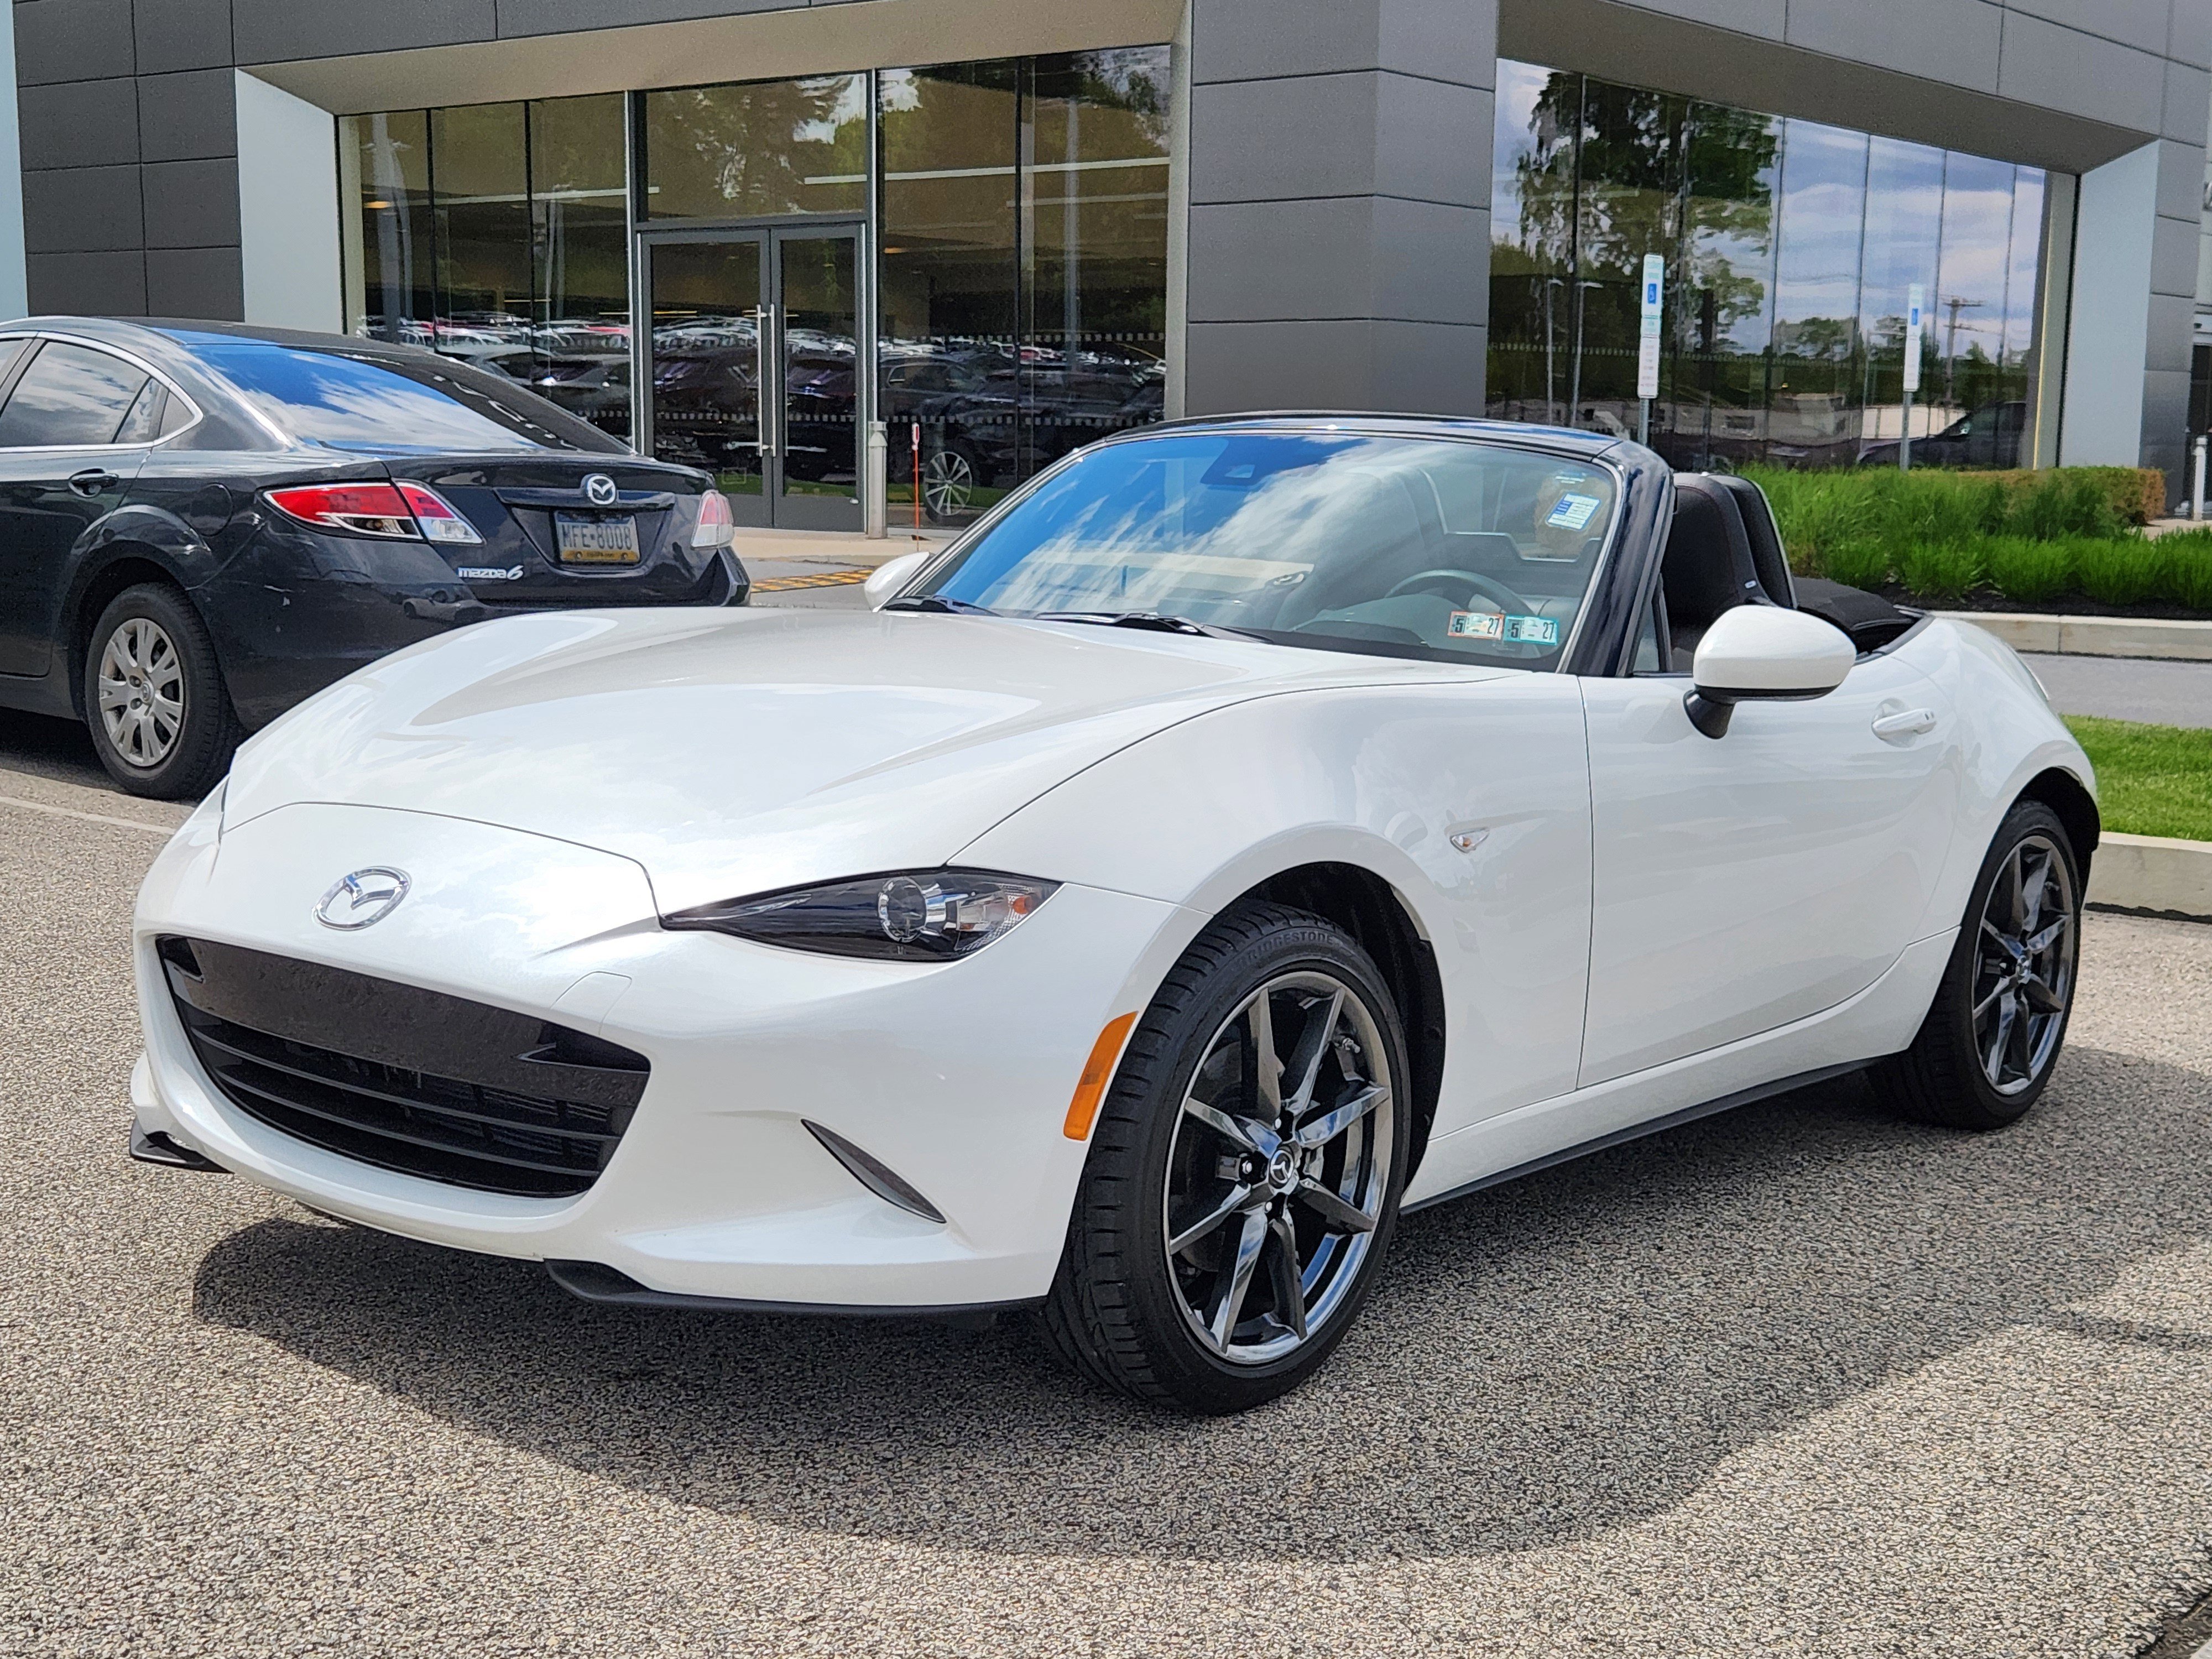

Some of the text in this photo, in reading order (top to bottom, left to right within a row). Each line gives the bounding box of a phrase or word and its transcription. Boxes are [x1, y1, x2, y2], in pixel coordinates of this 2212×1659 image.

[1454, 617, 1500, 636] 5 27
[1510, 622, 1554, 640] 5 27
